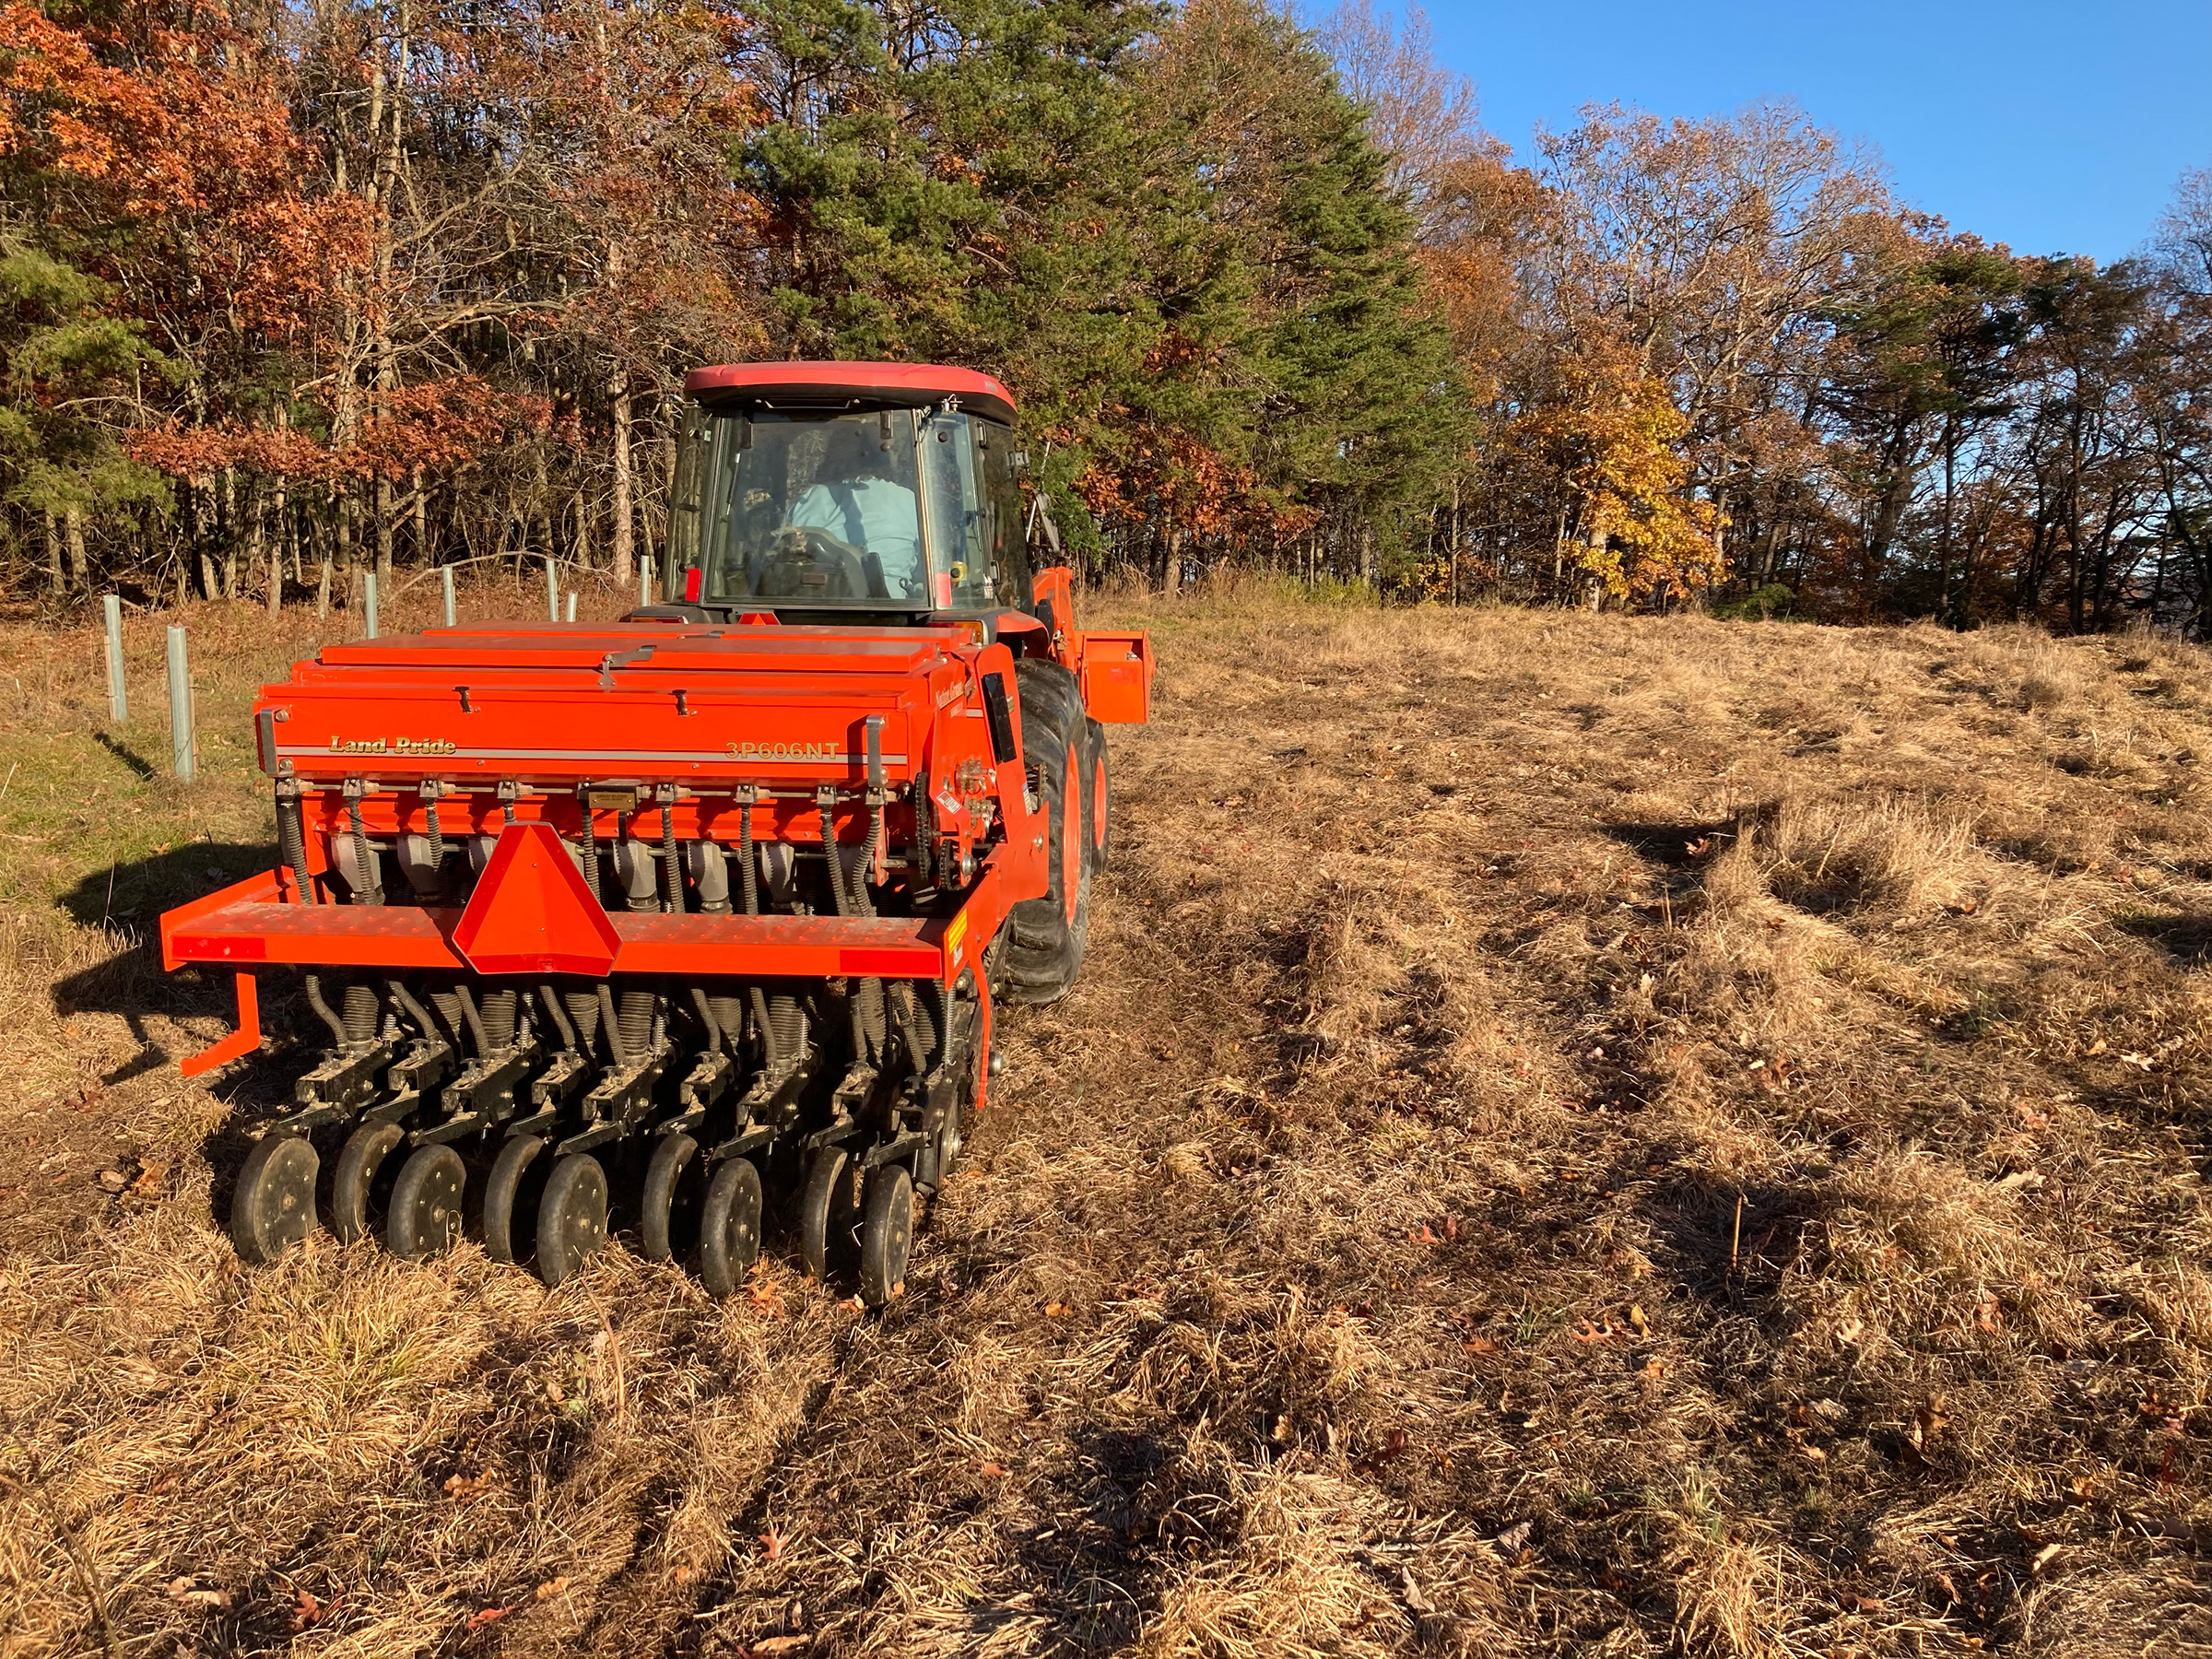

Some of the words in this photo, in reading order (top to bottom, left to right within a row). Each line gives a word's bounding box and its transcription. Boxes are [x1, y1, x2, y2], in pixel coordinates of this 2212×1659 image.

[329, 735, 387, 753] Land
[394, 736, 456, 755] Pride
[724, 741, 841, 759] 3P606NT
